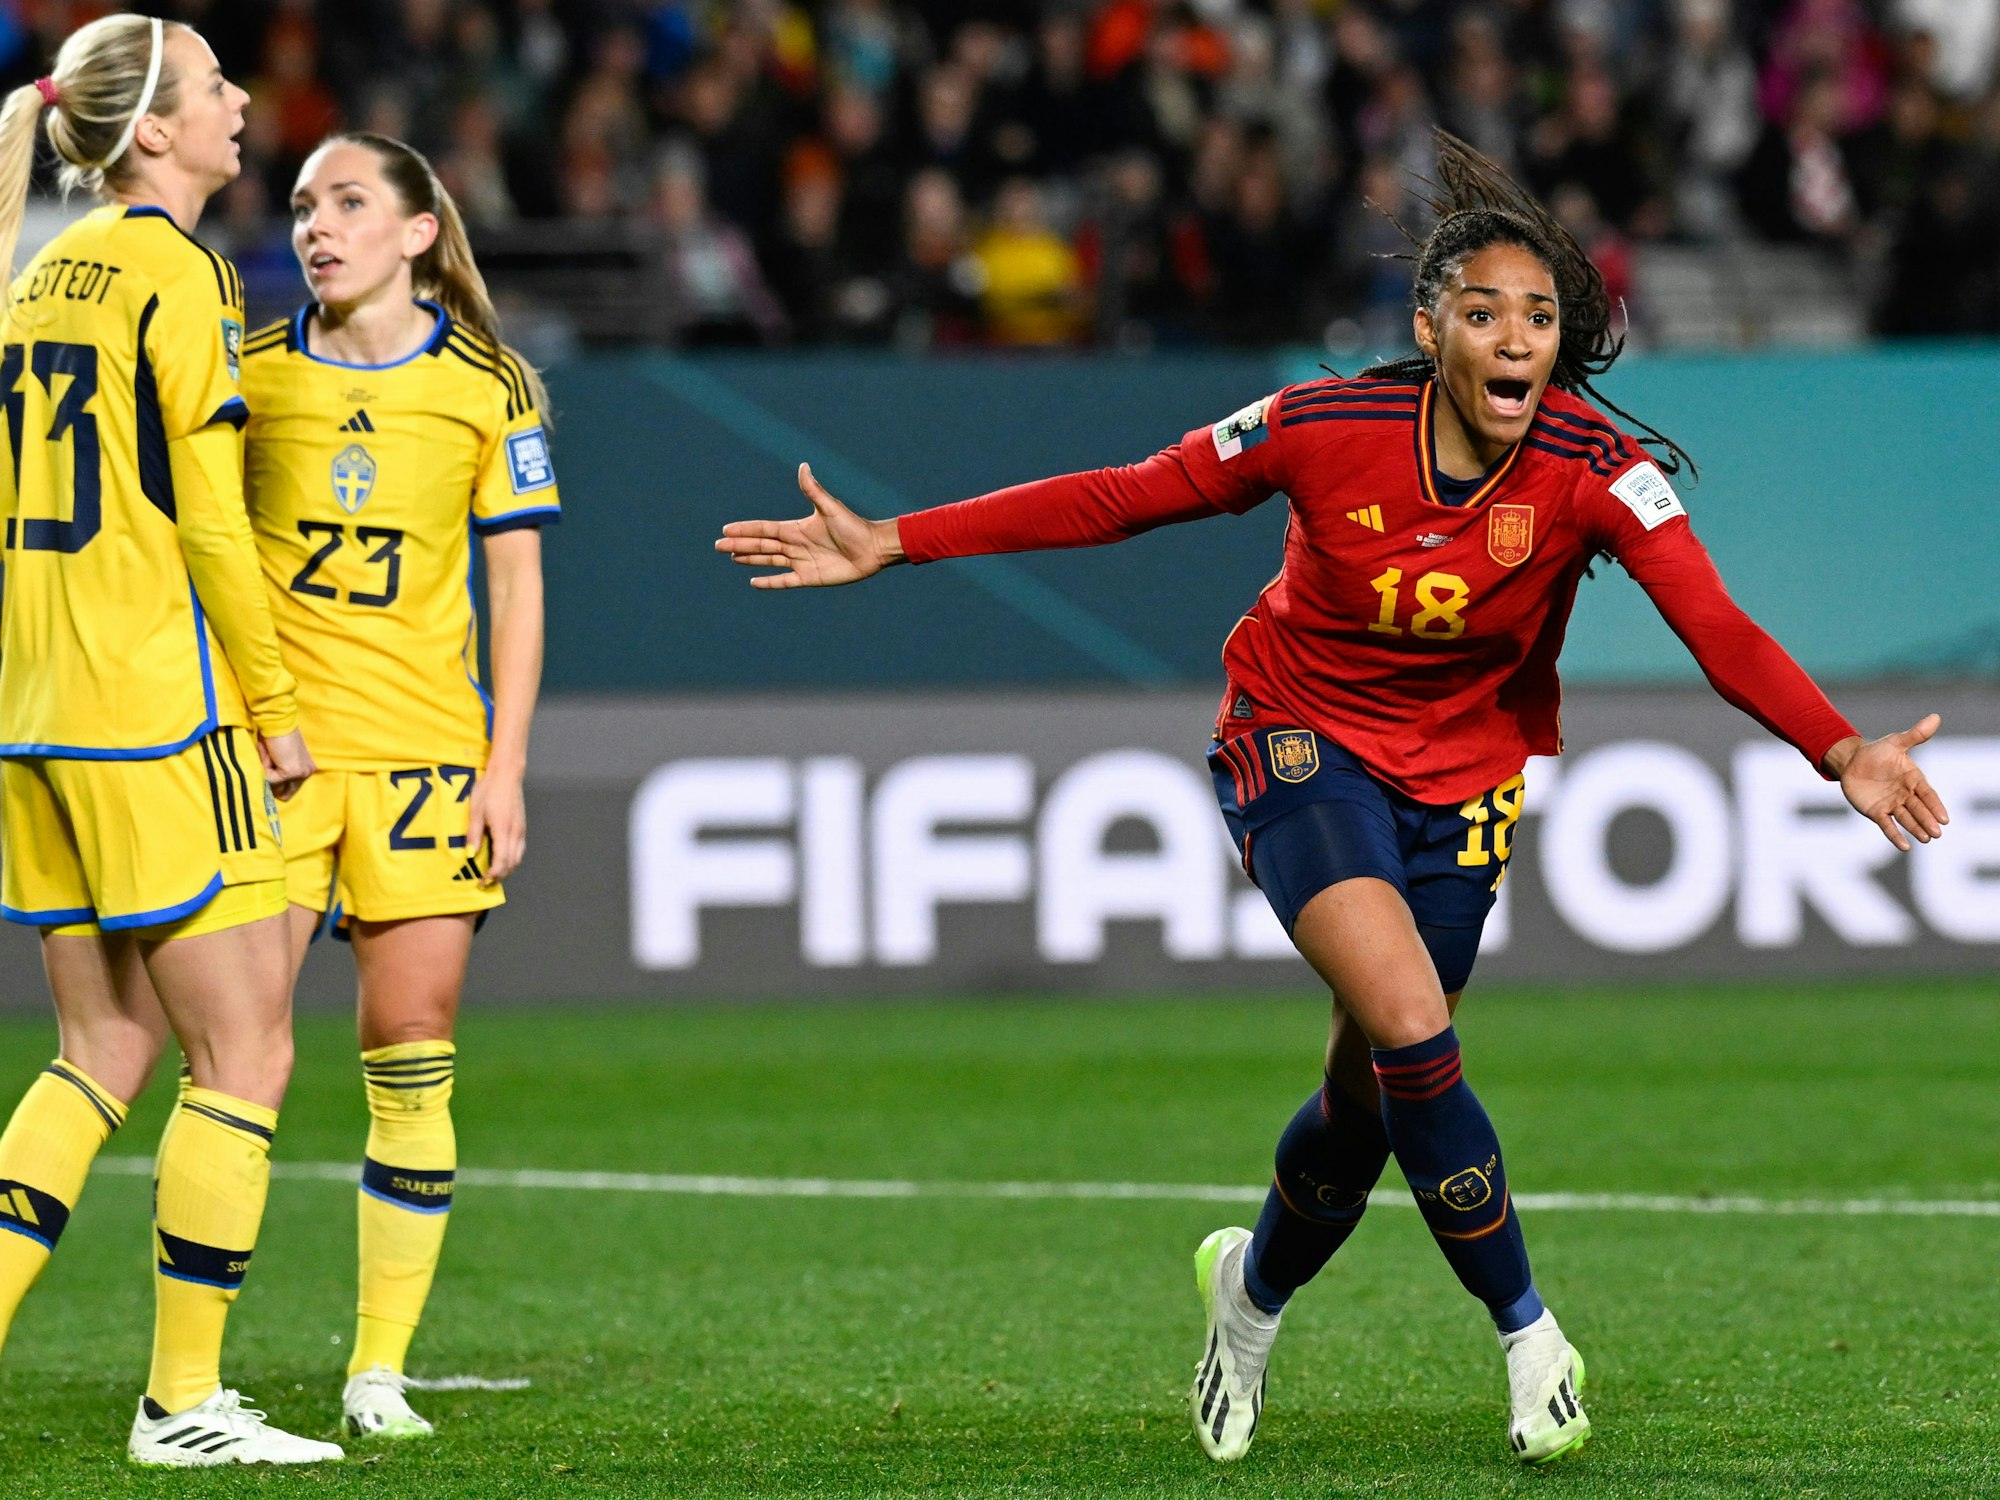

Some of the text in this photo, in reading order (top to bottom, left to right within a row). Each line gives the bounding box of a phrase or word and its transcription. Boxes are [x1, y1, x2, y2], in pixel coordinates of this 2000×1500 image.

[1633, 477, 1662, 497] UNITES
[290, 520, 404, 608] 23
[1368, 567, 1471, 641] 18
[1457, 773, 1525, 867] 18
